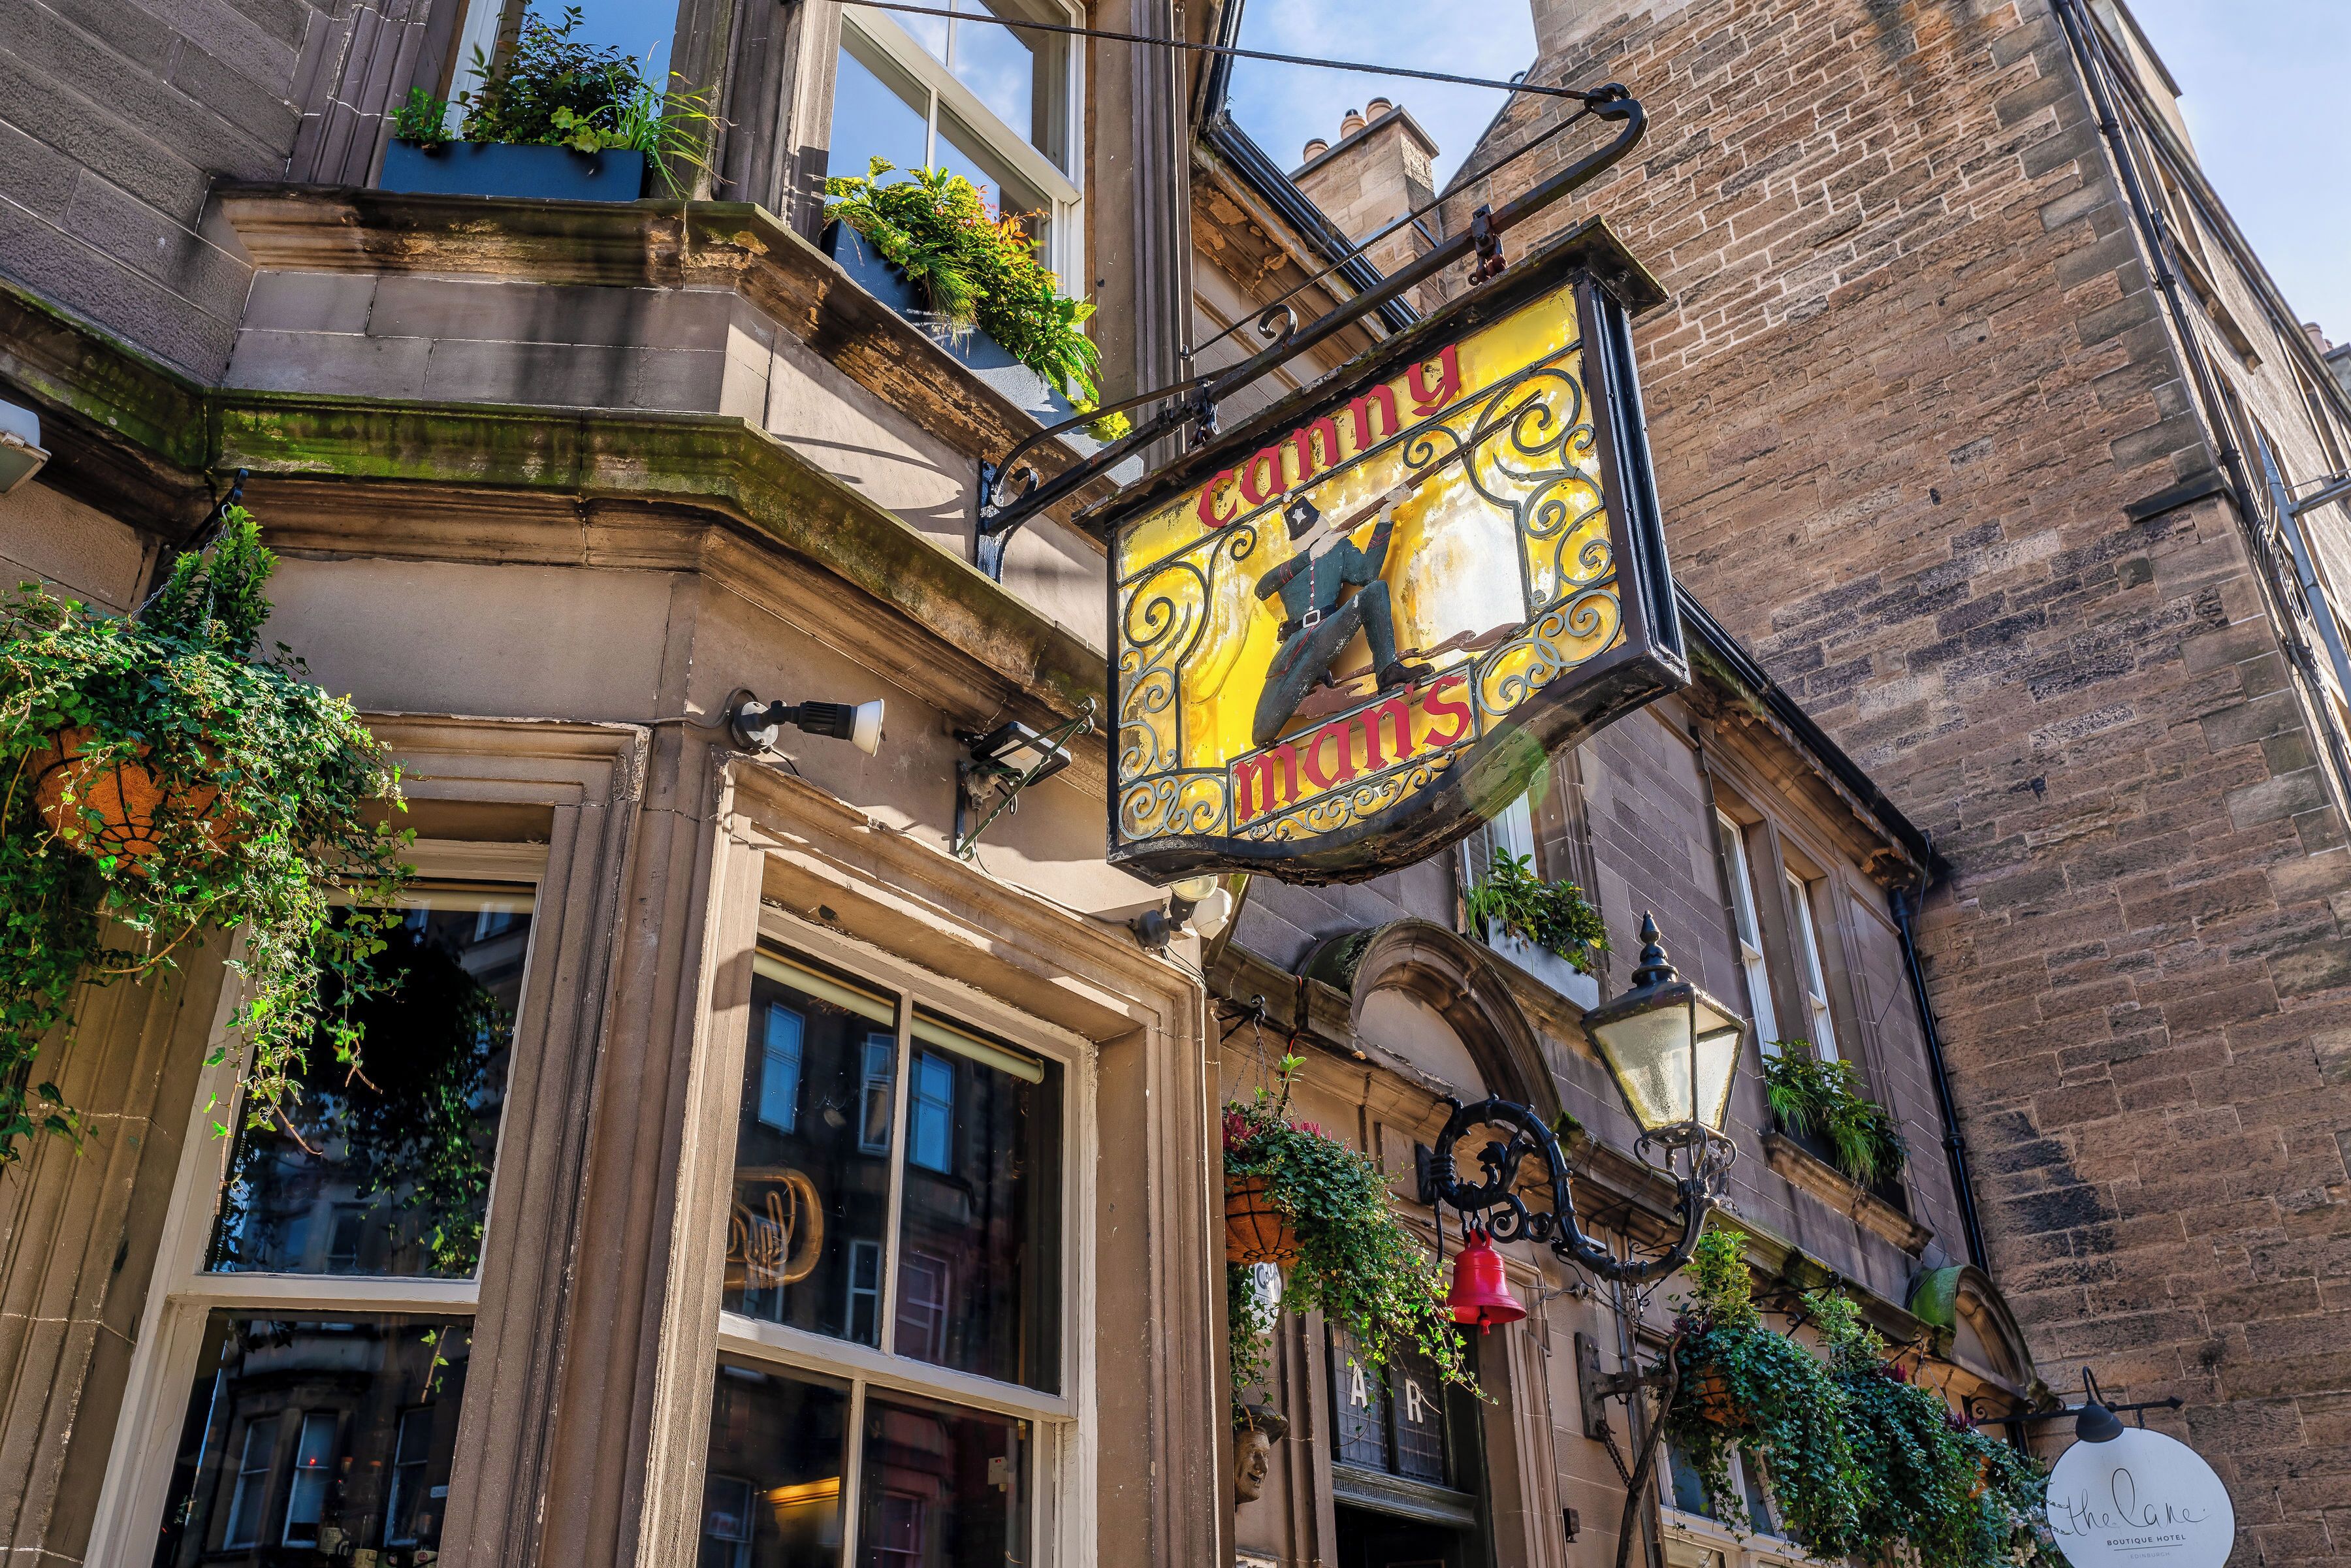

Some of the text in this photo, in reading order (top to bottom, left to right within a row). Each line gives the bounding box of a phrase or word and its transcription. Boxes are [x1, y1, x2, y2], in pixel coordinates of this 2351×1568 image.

[1234, 675, 1472, 822] man's
[2066, 1467, 2211, 1536] the lane
[2107, 1537, 2153, 1546] BOUTIQUE
